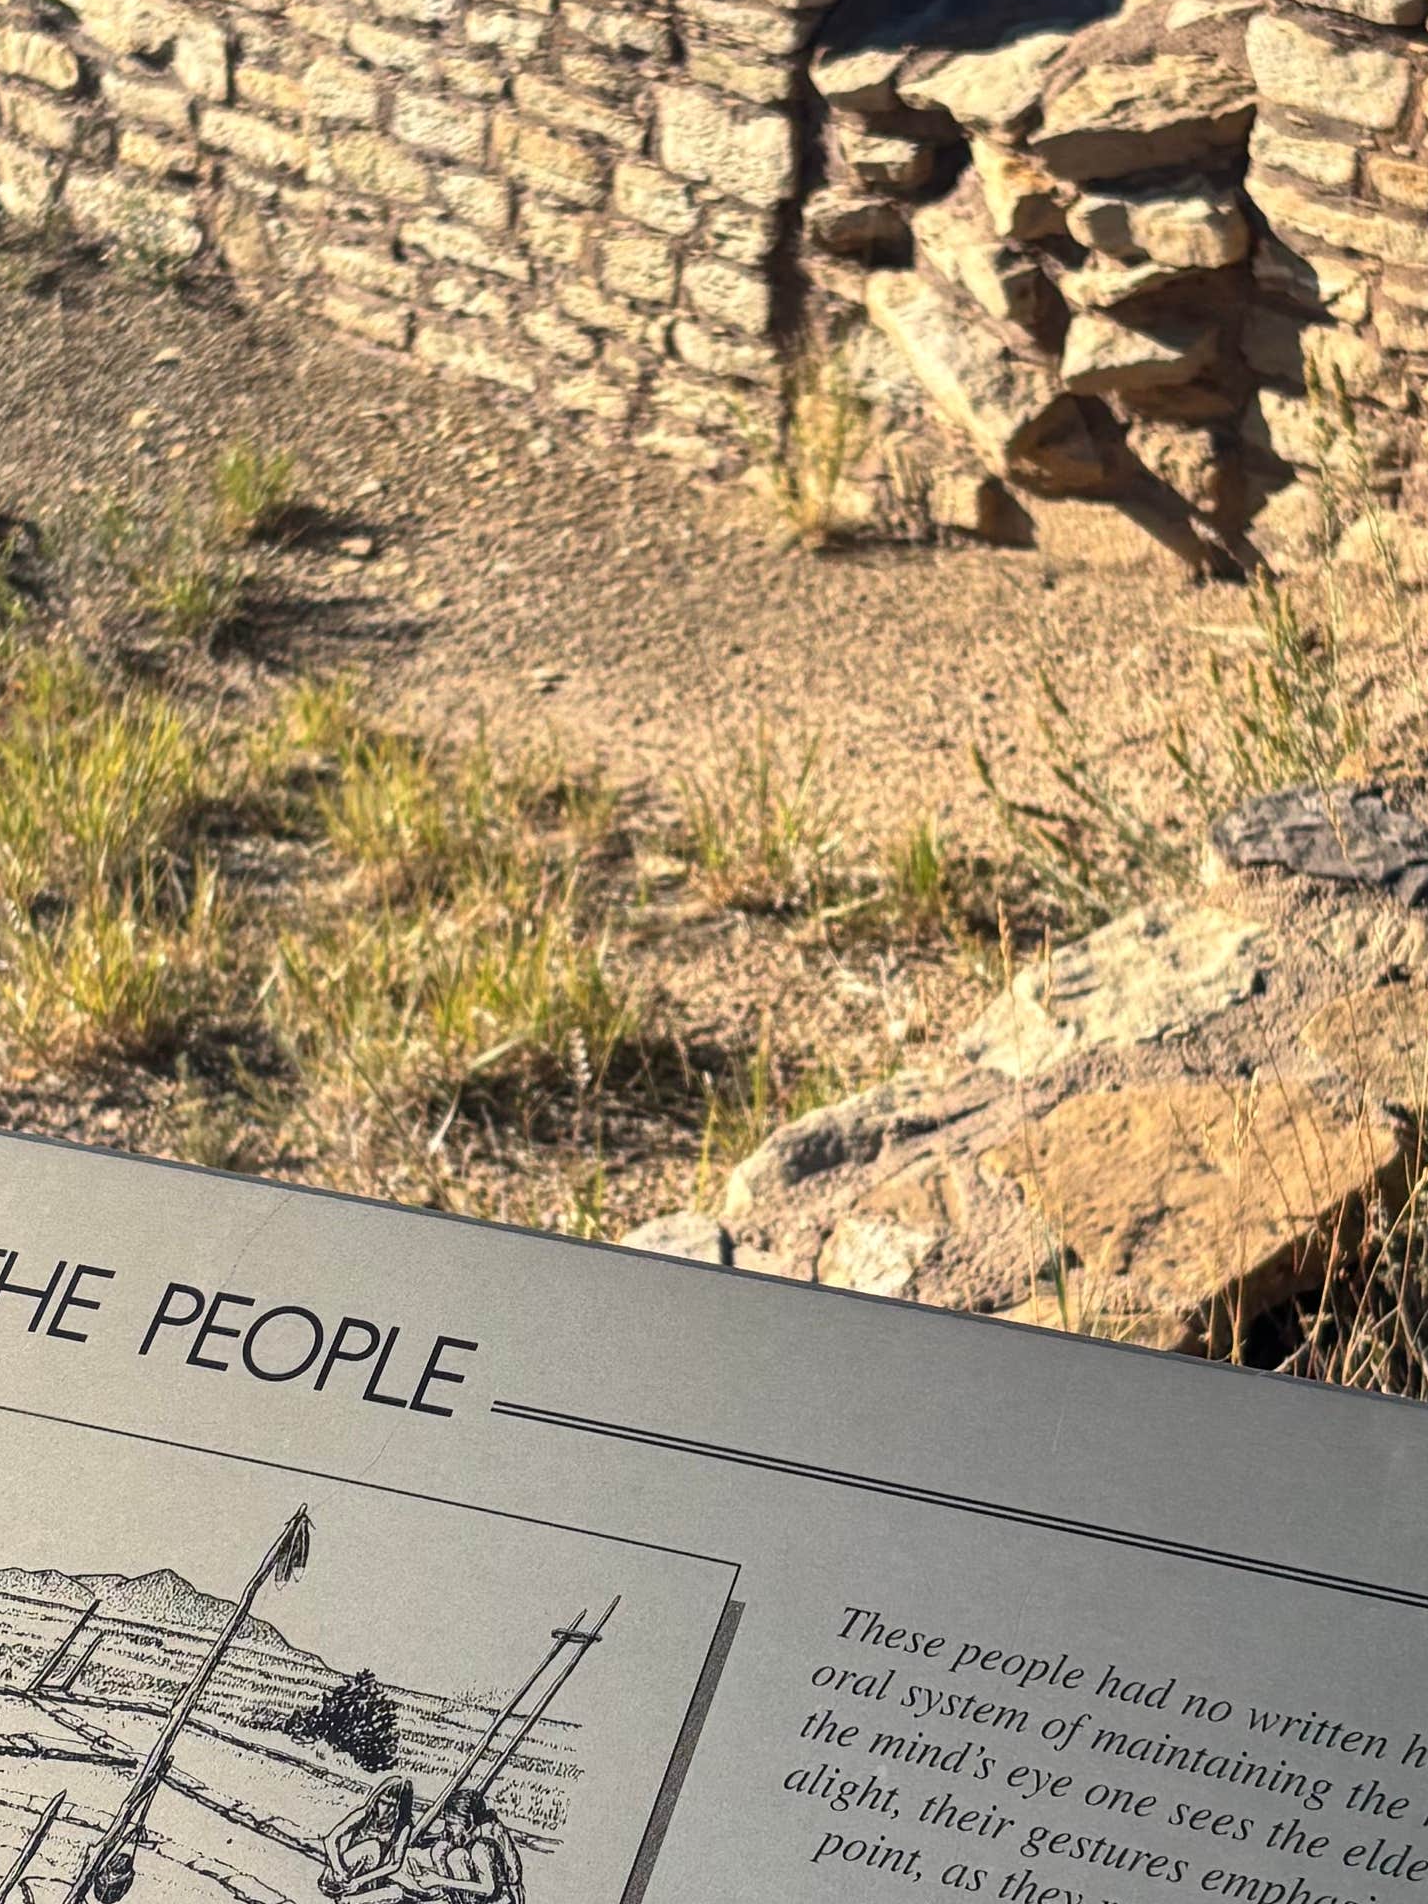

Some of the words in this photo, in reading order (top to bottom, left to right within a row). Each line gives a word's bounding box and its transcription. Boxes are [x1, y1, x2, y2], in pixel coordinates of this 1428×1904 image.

[136, 1279, 480, 1419] PEOPLE
[809, 1664, 897, 1702] oral
[898, 1683, 1030, 1734] system
[1039, 1711, 1094, 1753] of
[1088, 1727, 1334, 1812] maintaining
[1343, 1778, 1411, 1821] the
[835, 1604, 947, 1659] These
[946, 1641, 1086, 1691] people
[1093, 1662, 1178, 1711] had
[1179, 1692, 1234, 1724] no
[1247, 1706, 1389, 1760] written
[781, 1761, 901, 1821] alight,
[916, 1791, 1016, 1840] their
[1017, 1824, 1191, 1884] gestures
[798, 1707, 861, 1749] the
[866, 1729, 997, 1781] mind’s
[1004, 1764, 1074, 1801] eye
[1082, 1782, 1158, 1818] one
[1165, 1801, 1256, 1842] sees
[1264, 1816, 1331, 1859] the
[807, 1830, 923, 1884] point,
[939, 1862, 989, 1893] as
